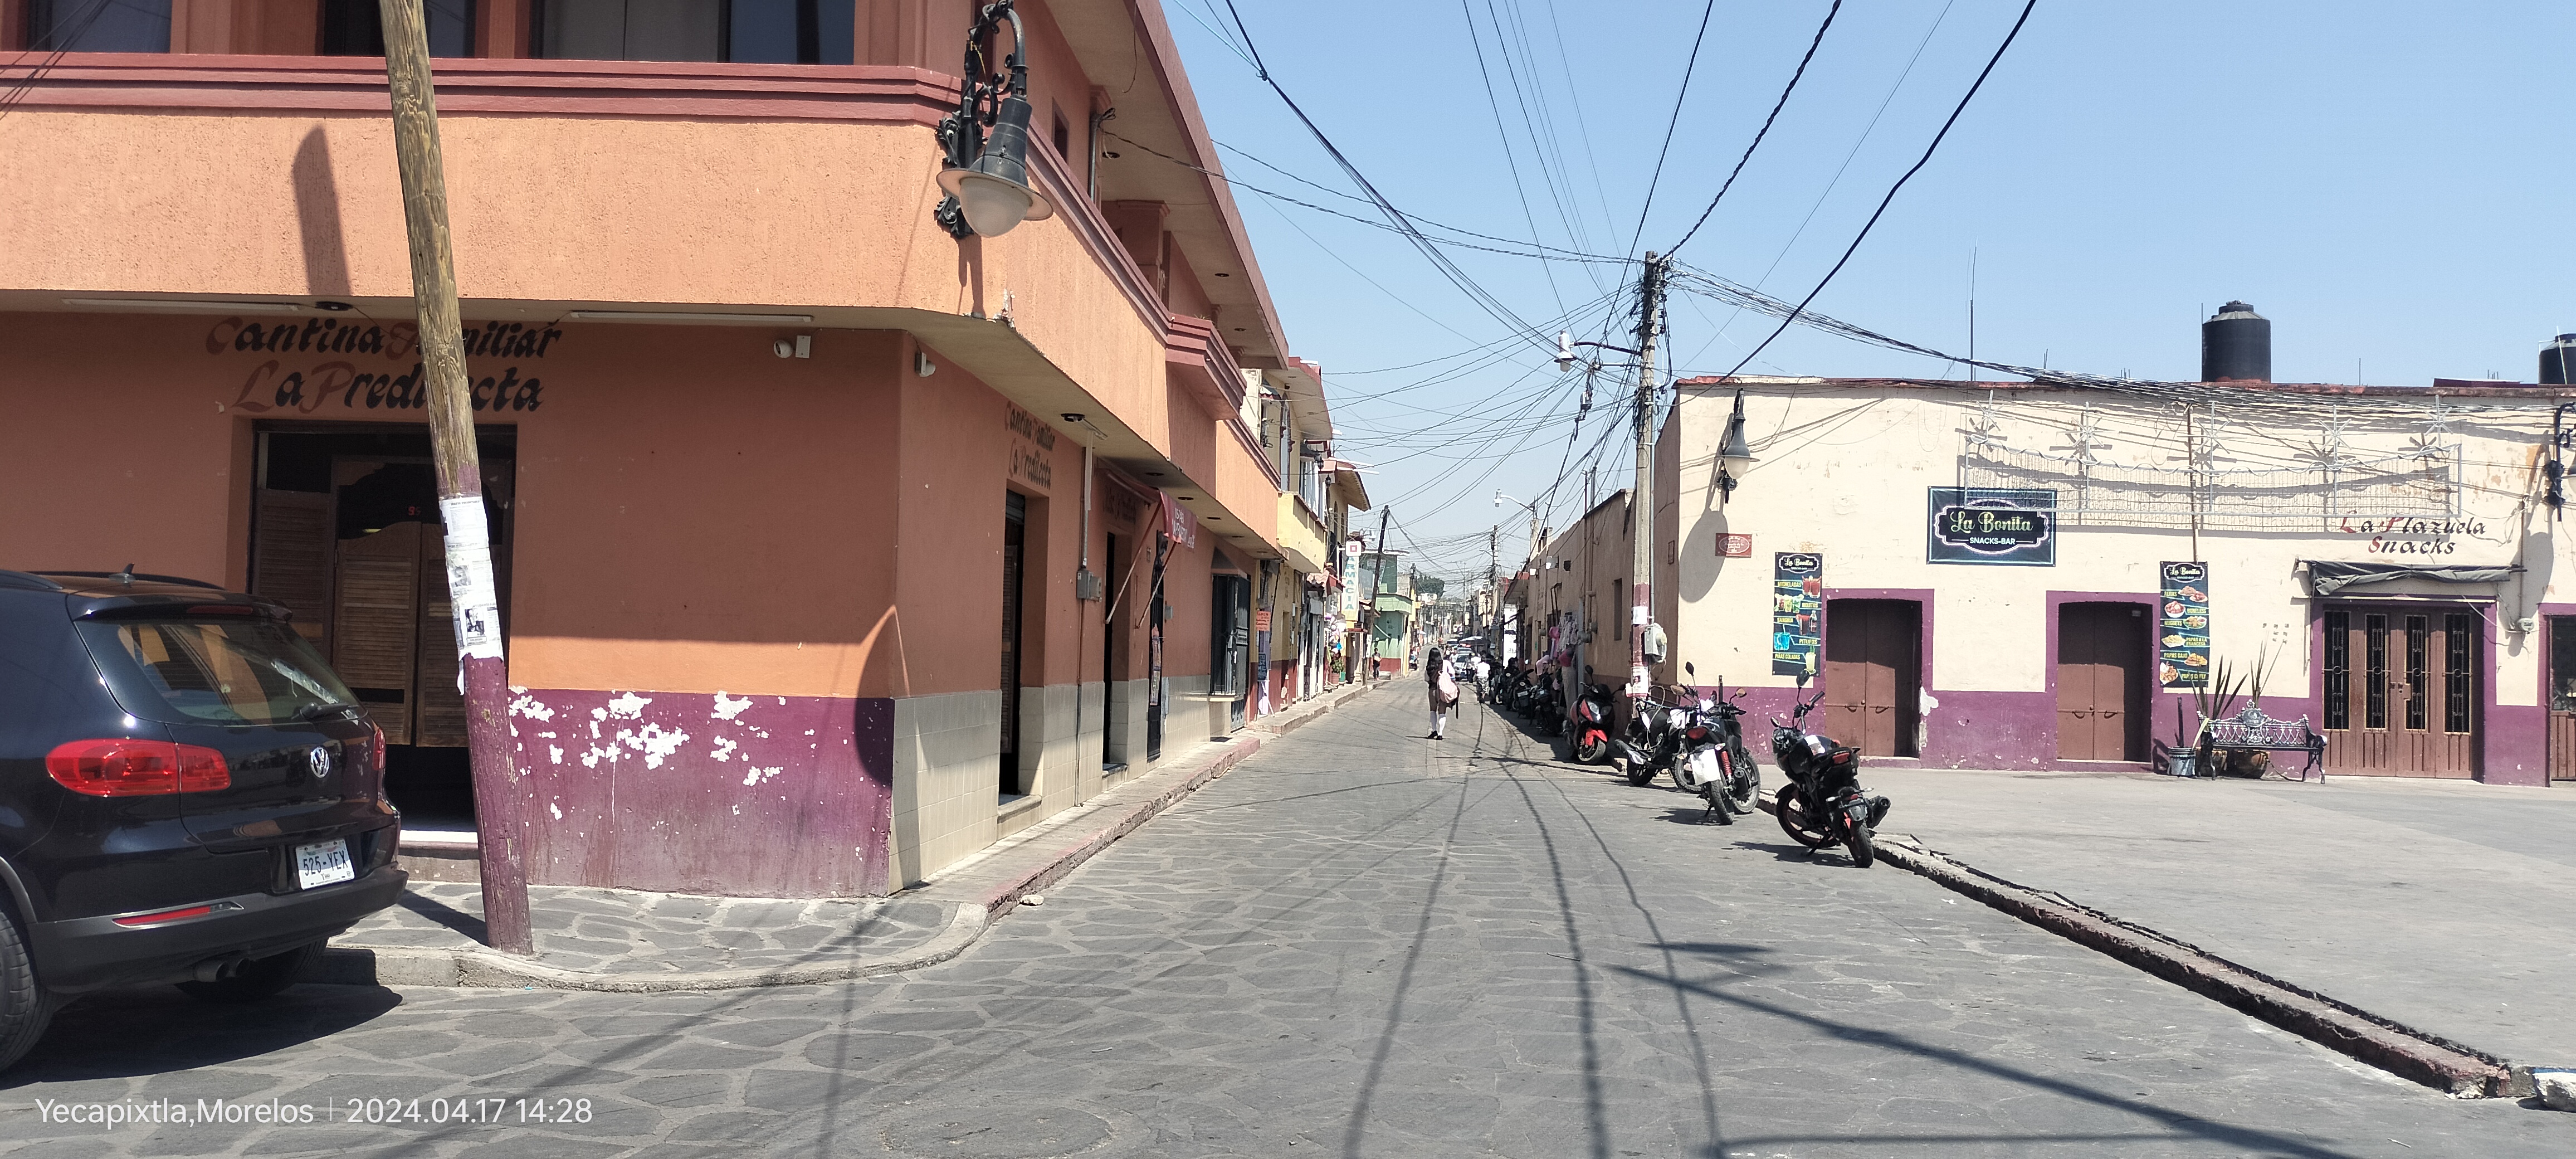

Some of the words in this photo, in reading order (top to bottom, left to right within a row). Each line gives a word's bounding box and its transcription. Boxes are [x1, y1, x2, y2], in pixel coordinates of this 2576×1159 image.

[206, 316, 385, 356] Cantina
[385, 321, 563, 360] Filiar
[230, 360, 306, 413] La
[299, 361, 544, 414] Predicta
[1950, 511, 1975, 534] La
[1978, 511, 2033, 533] Bonita
[2339, 510, 2374, 533] La
[2379, 517, 2486, 535] Plazuela
[1969, 537, 2016, 545] SNACKS-BAR
[2368, 535, 2456, 554] Snacks
[2169, 567, 2179, 576] La
[303, 850, 348, 876] 525-YEX
